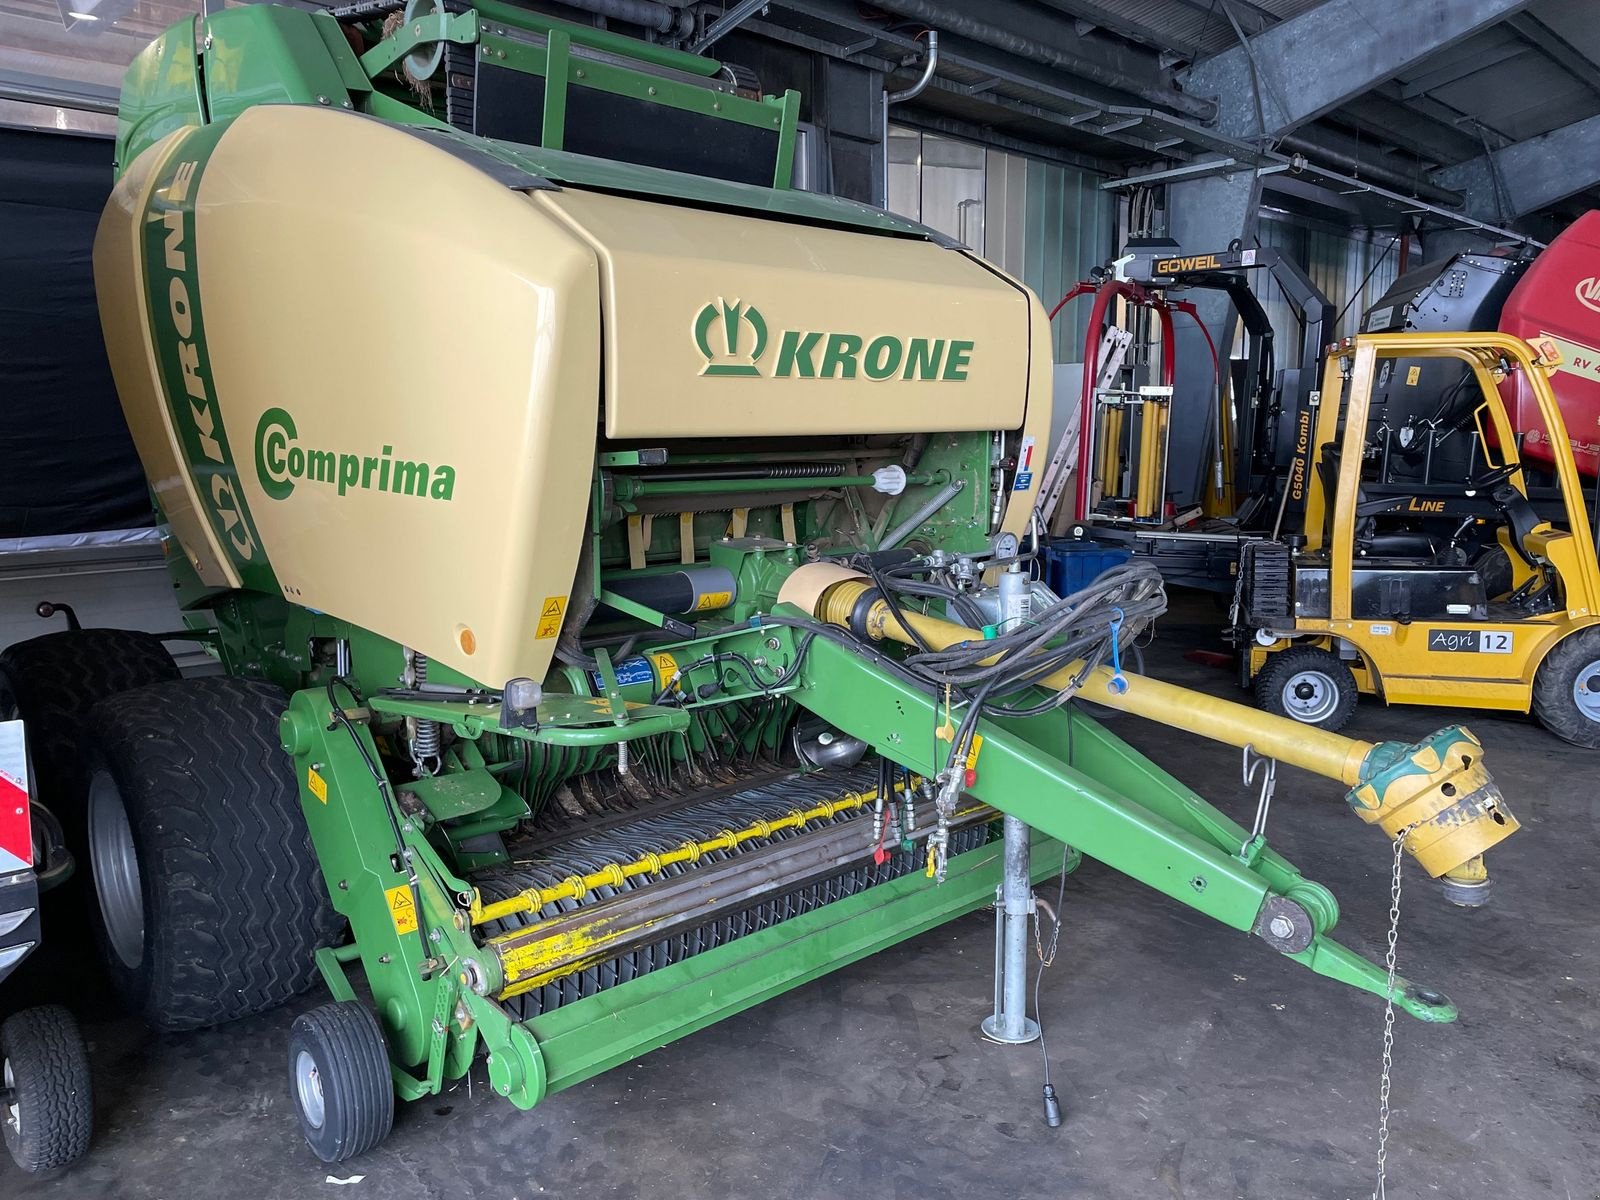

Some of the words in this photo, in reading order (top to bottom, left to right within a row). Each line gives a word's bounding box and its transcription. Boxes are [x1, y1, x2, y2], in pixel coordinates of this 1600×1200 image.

[164, 160, 224, 465] KRONE
[771, 330, 975, 382] KRONE
[1573, 357, 1591, 370] RV
[254, 407, 456, 501] Comprima
[1297, 410, 1310, 454] Kombi
[1292, 459, 1305, 500] G5040
[1431, 632, 1474, 650] Agri
[1484, 635, 1508, 650] 12
